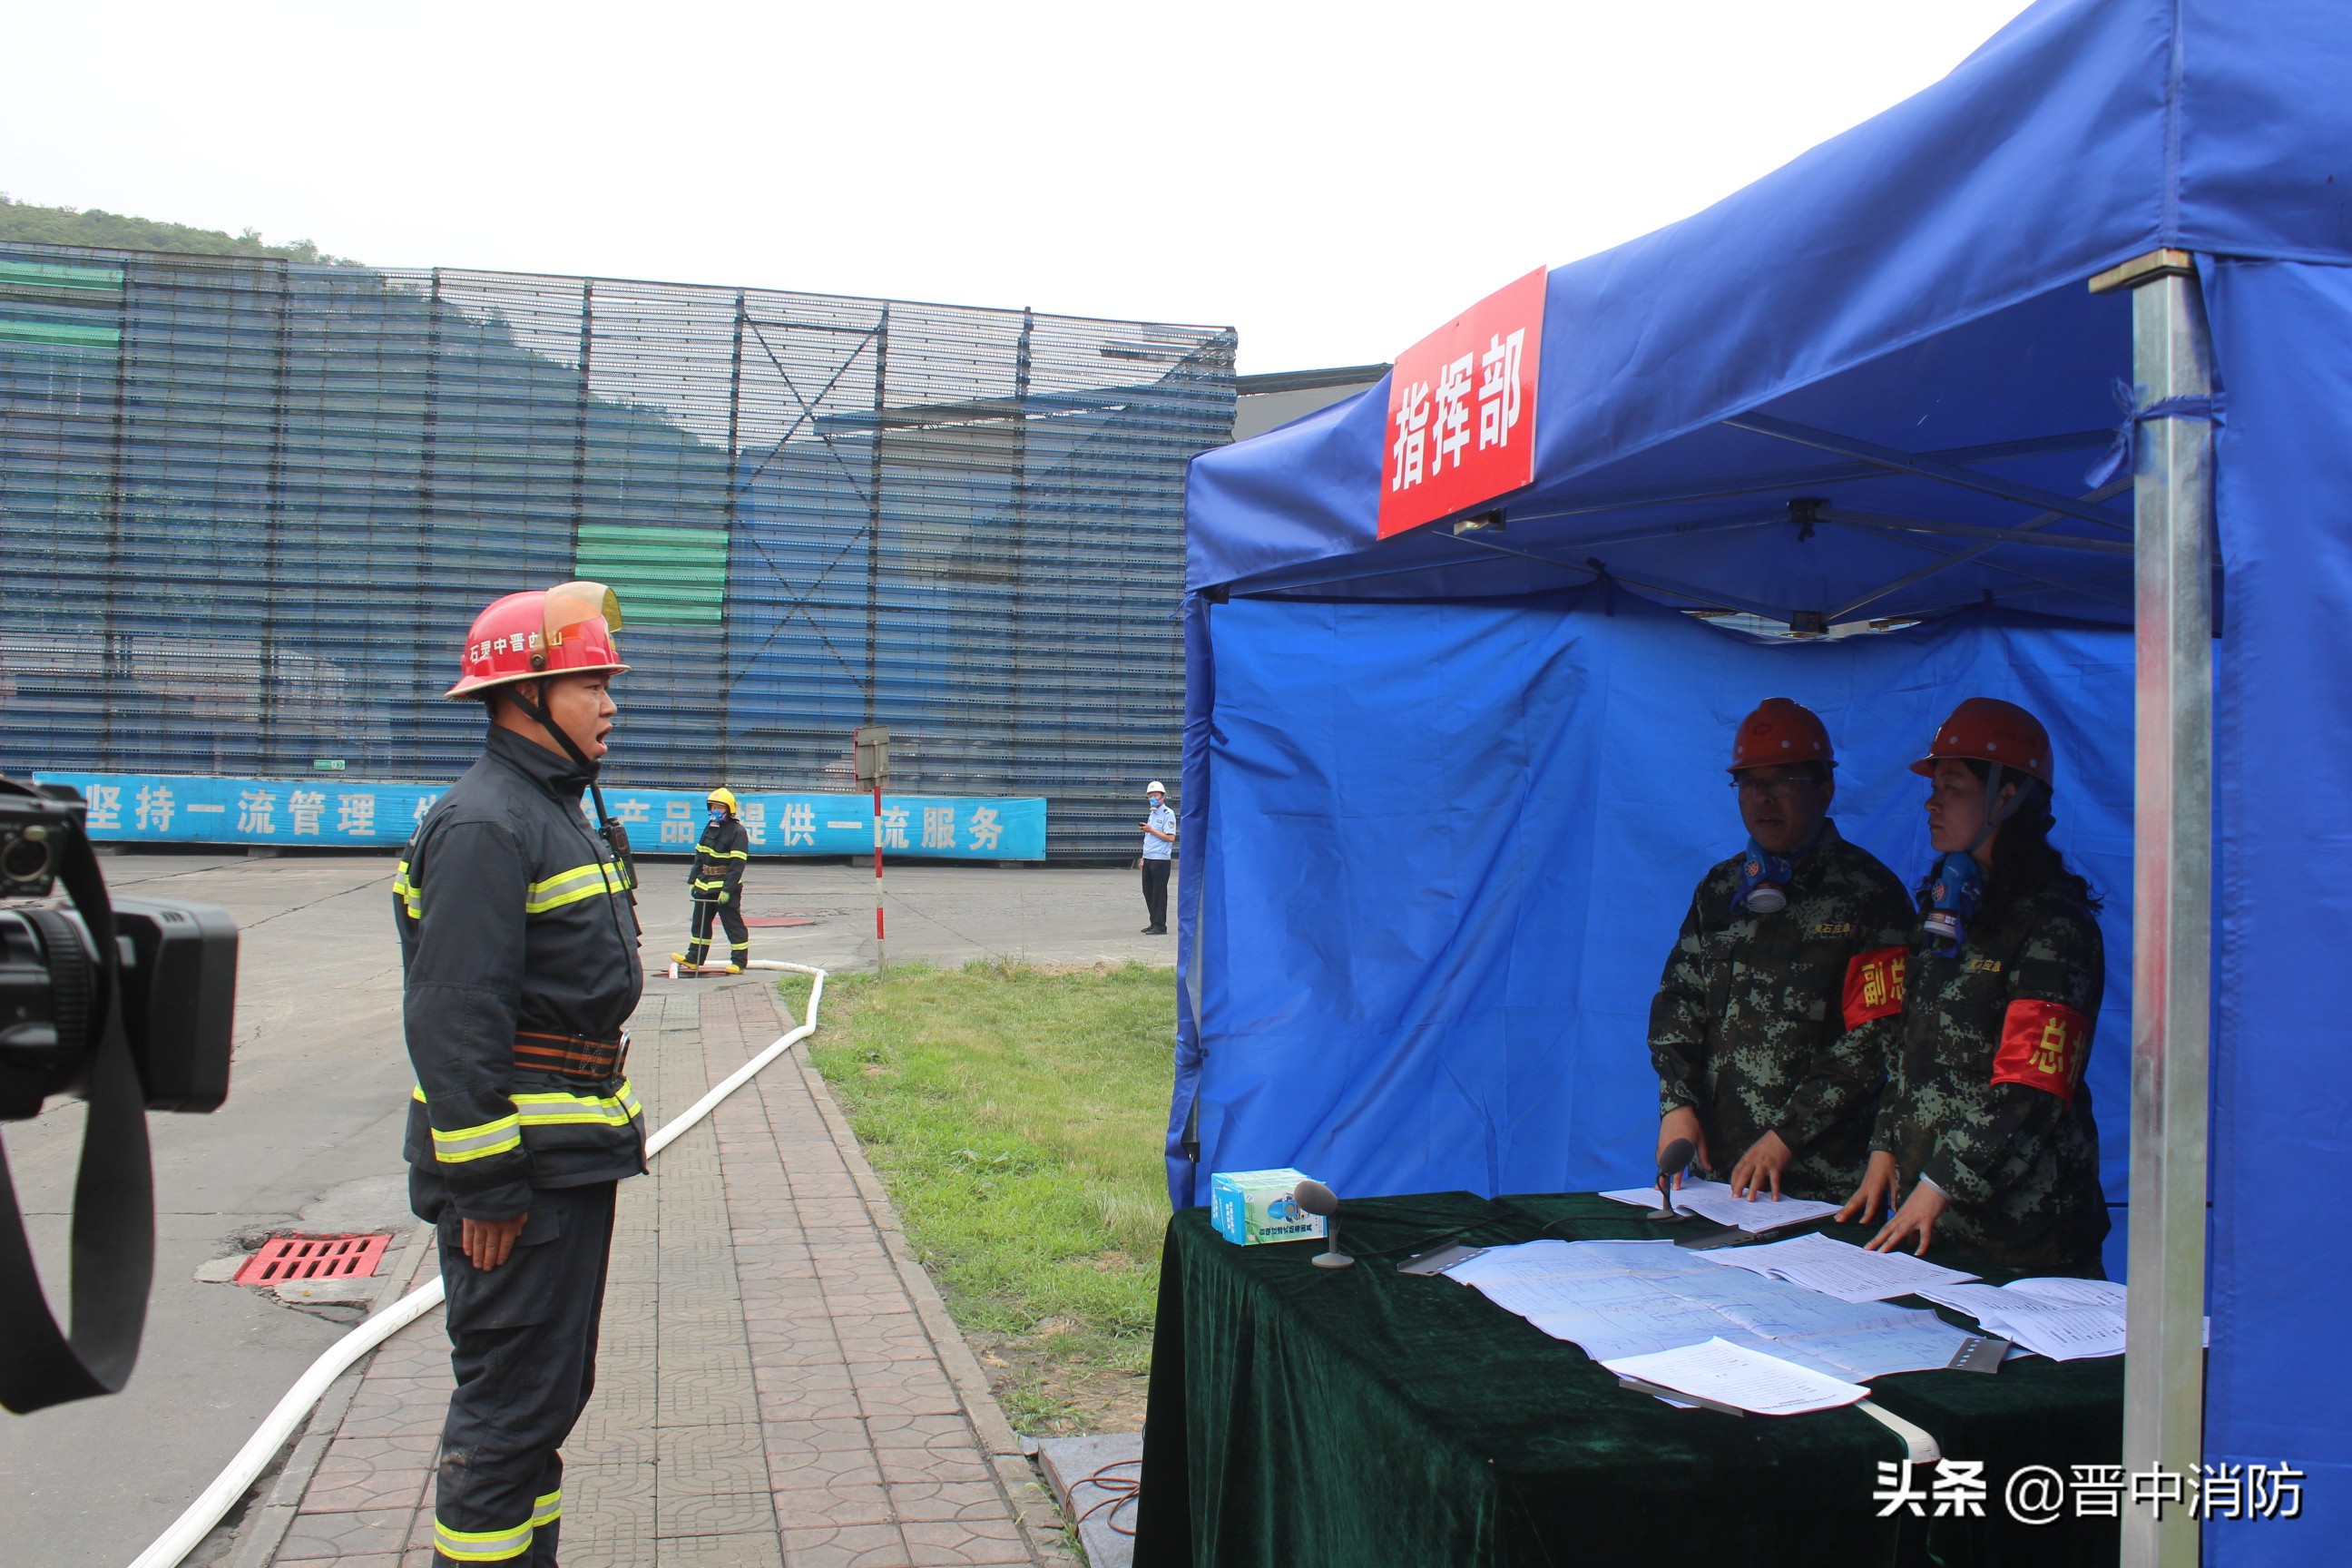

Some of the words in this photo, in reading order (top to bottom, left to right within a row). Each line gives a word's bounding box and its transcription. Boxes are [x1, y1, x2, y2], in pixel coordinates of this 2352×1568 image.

[1392, 328, 1525, 492] 指挥部
[86, 784, 376, 837] 坚持一流管理
